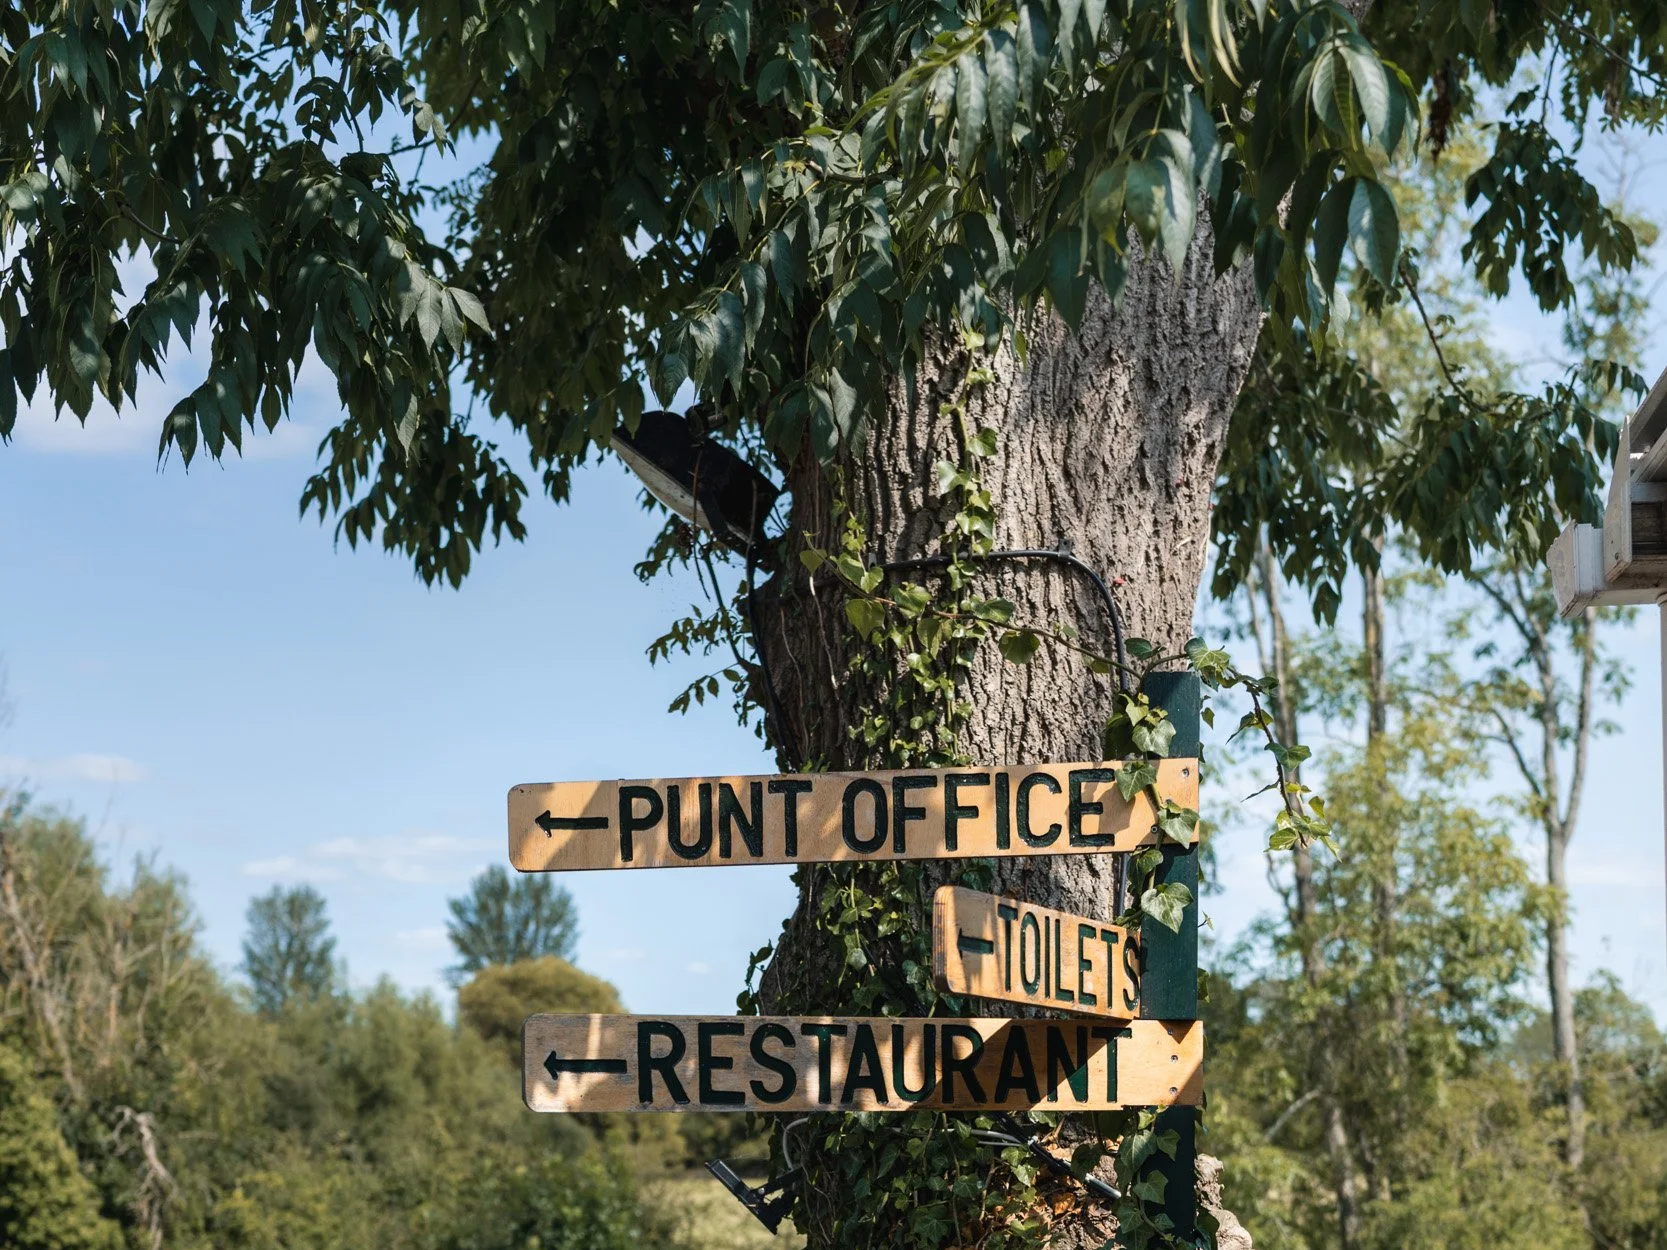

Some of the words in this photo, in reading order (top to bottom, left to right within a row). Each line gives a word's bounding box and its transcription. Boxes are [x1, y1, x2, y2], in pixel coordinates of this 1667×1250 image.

[618, 780, 812, 862] PUNT
[842, 768, 1116, 853] OFFICE
[997, 903, 1140, 1012] TOILETS
[636, 1020, 1132, 1105] RESTAURANT
